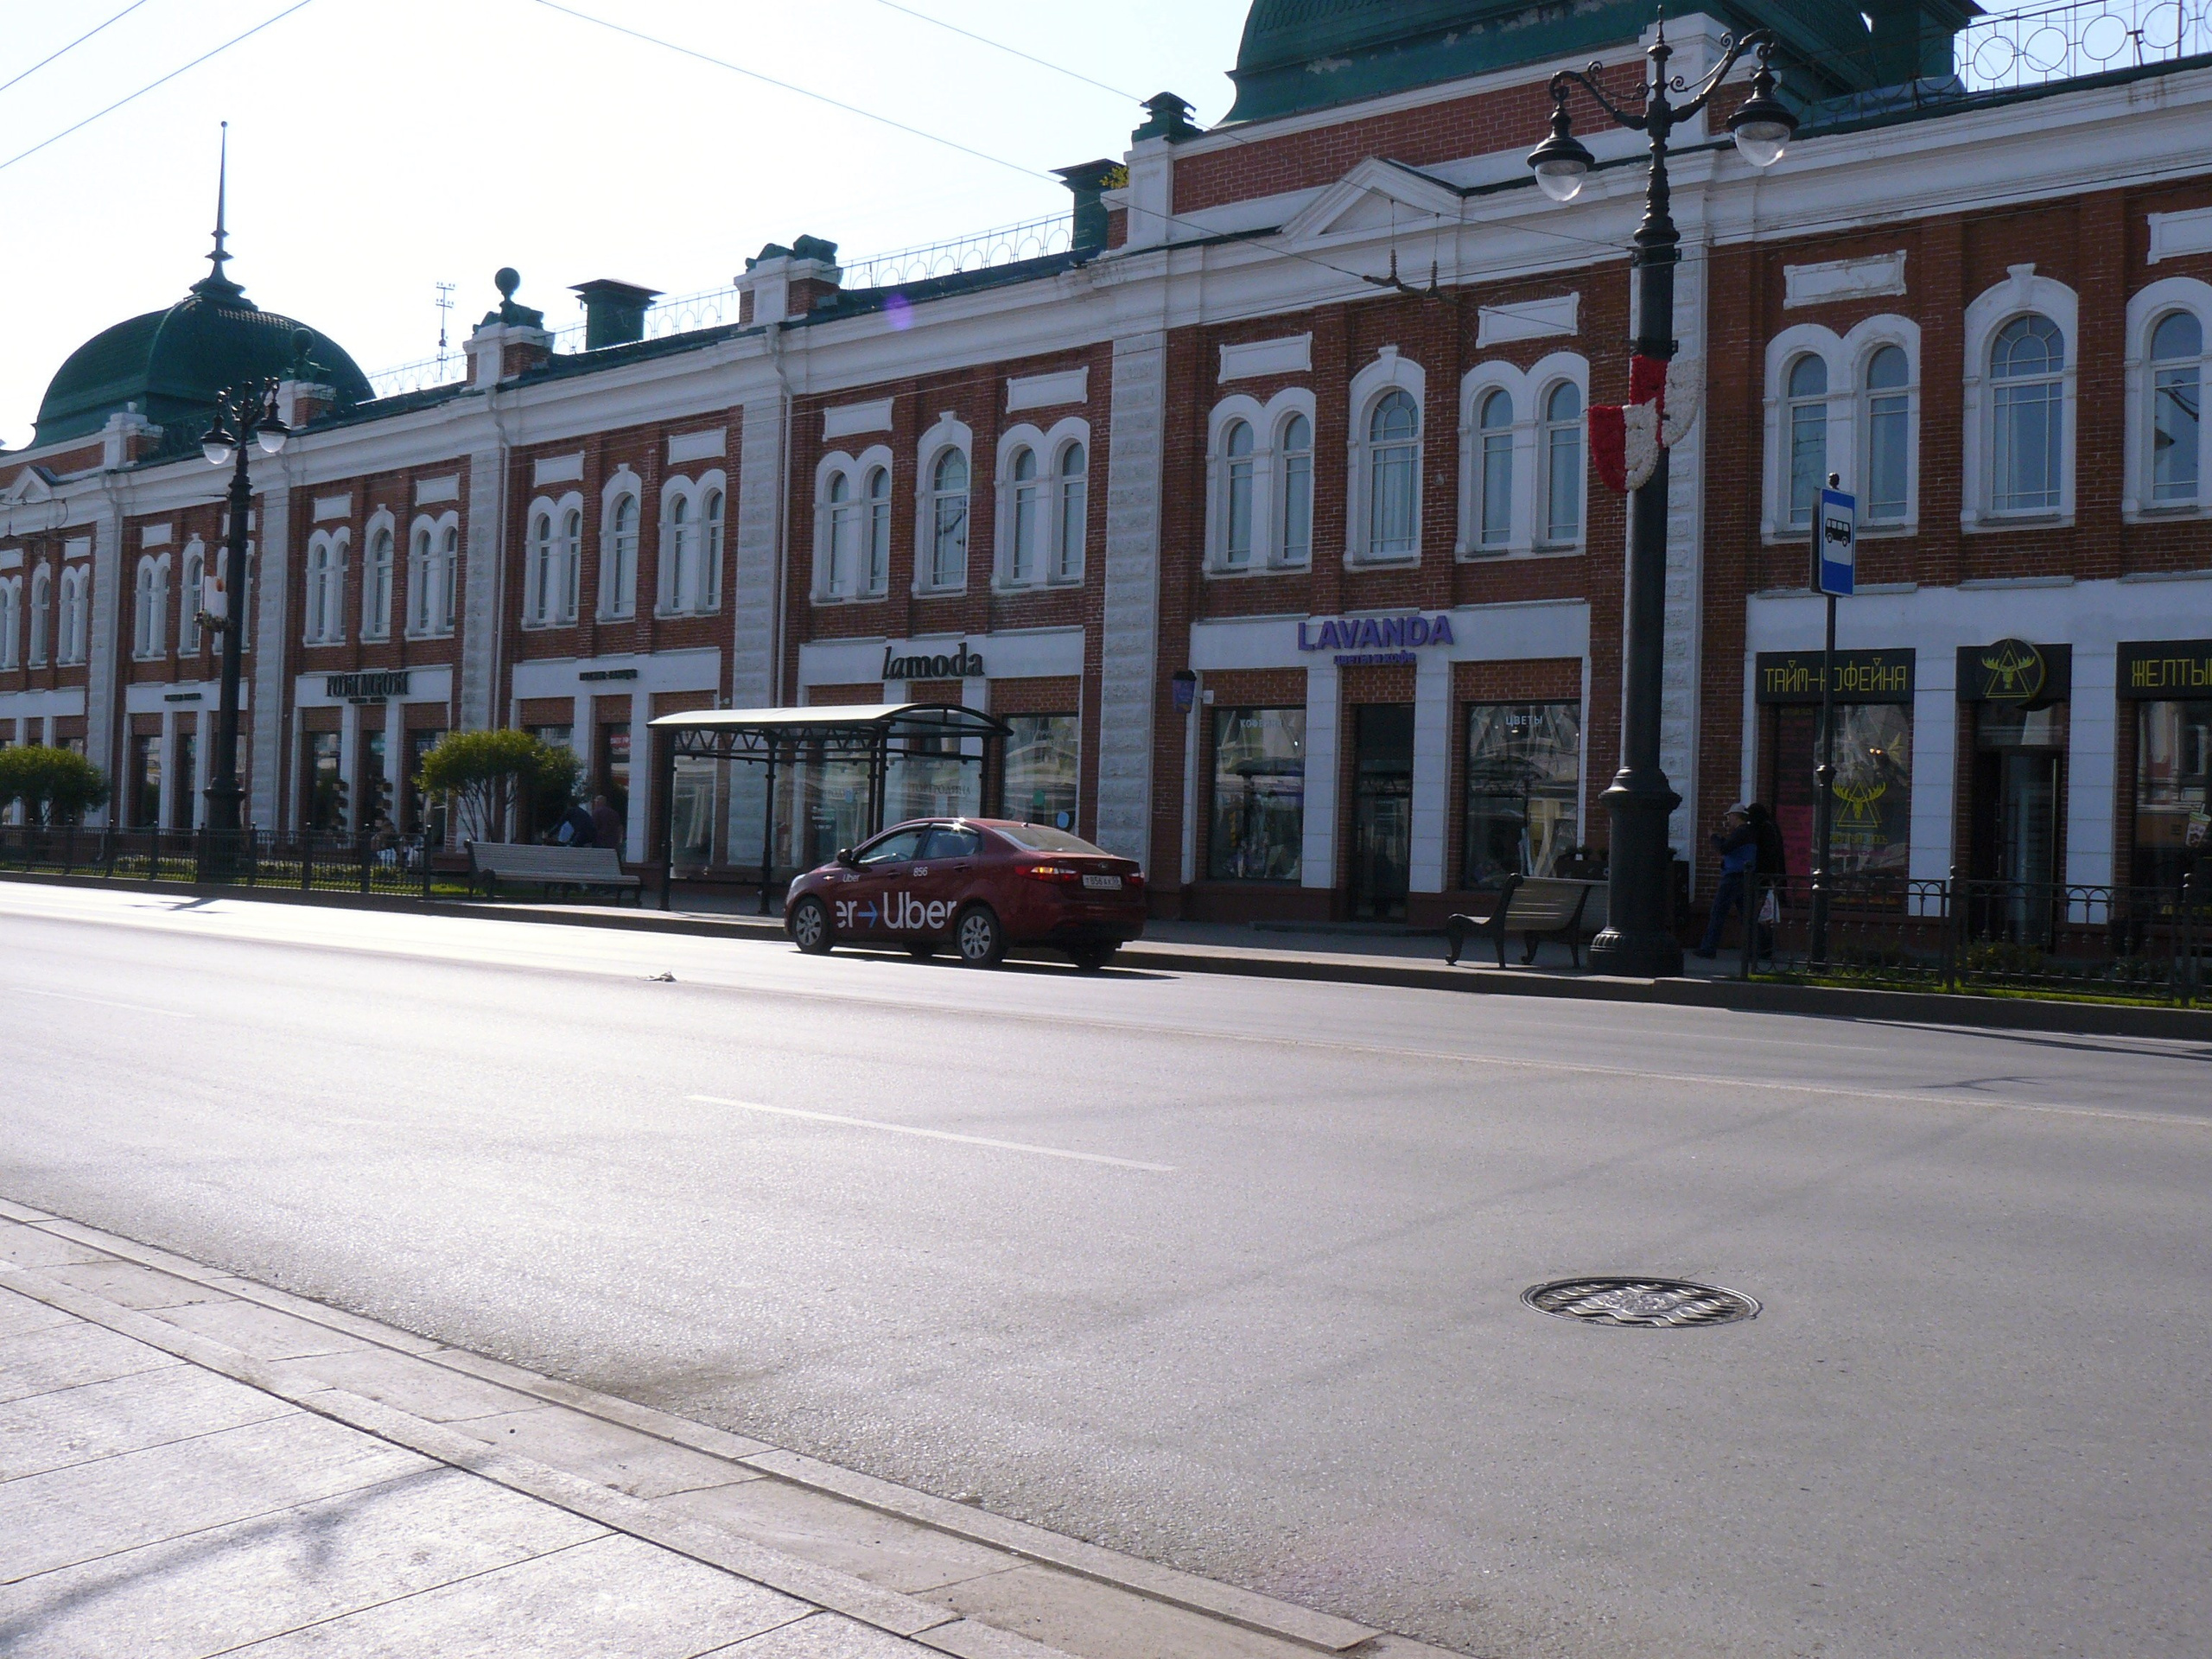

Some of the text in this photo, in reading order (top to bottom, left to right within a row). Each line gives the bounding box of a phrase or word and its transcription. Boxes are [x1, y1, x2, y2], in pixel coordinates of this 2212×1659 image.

[1298, 615, 1453, 652] LAVANDA
[881, 642, 985, 679] lamoda
[2131, 658, 2212, 688] ЖЕЛТЫ
[1506, 715, 1543, 728] ЦВЕТЫ
[842, 874, 861, 883] Uber
[913, 867, 929, 878] 856
[883, 892, 957, 930] Uber
